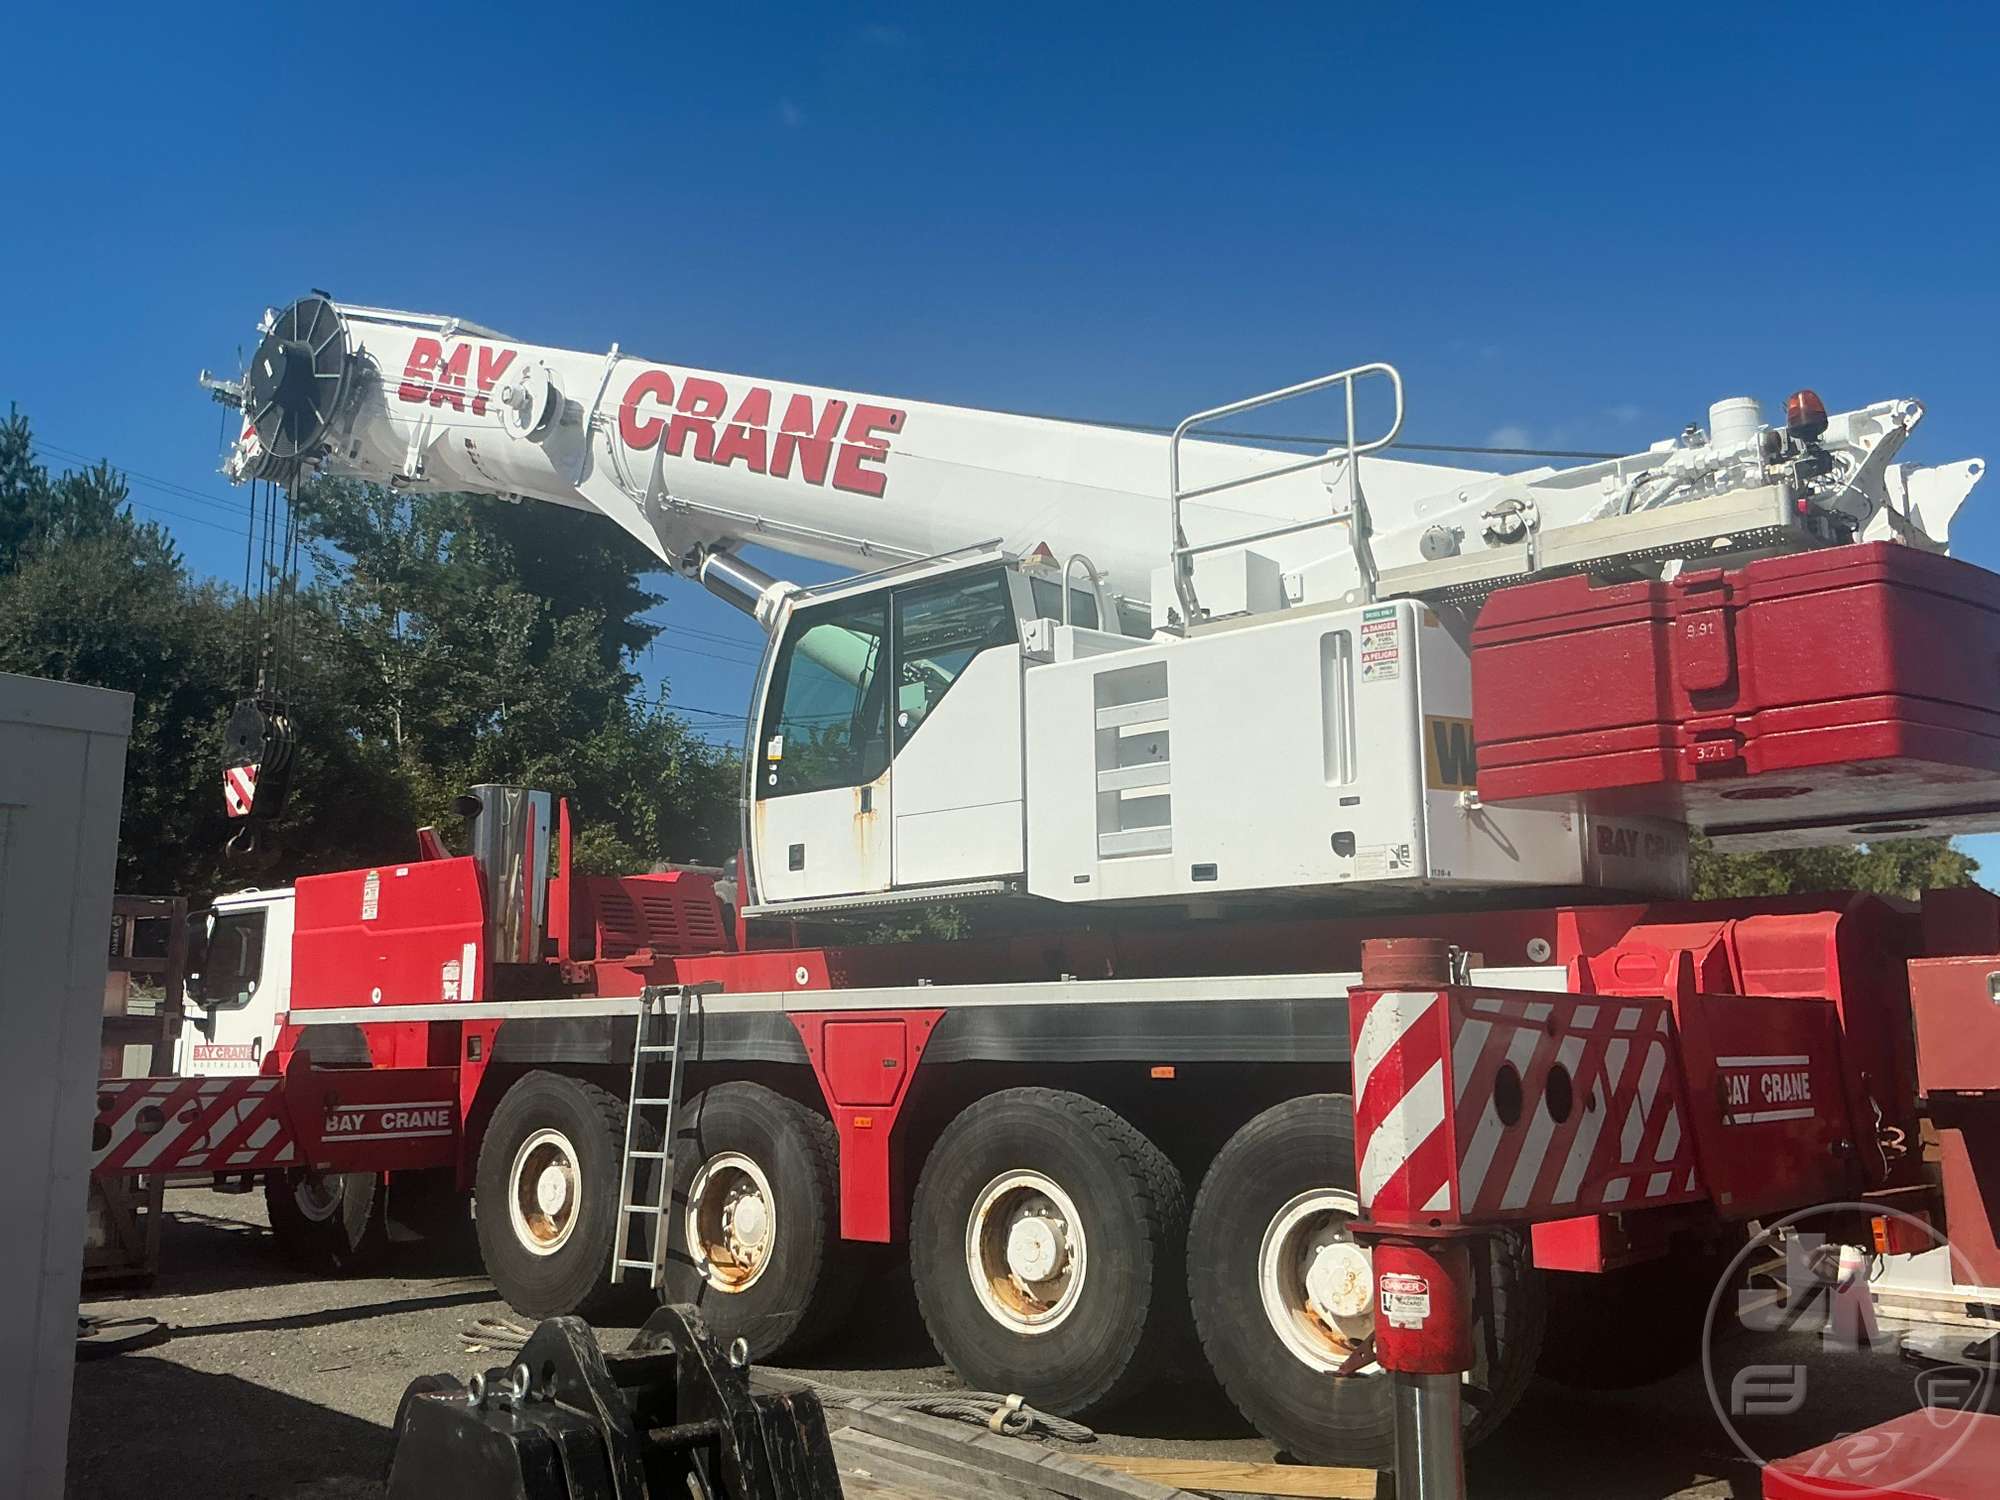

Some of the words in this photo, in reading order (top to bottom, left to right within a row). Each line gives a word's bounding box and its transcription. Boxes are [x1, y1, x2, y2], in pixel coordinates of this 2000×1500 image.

[398, 336, 518, 417] BAY
[619, 370, 907, 499] CRANE
[1369, 621, 1396, 632] DANGER
[1370, 650, 1397, 661] PELIGRO
[1596, 825, 1640, 858] BAY
[194, 1046, 214, 1058] BAY
[216, 1046, 253, 1058] CRANE
[1761, 1072, 1811, 1103] CRANE
[325, 1113, 365, 1132] BAY
[381, 1110, 450, 1130] CRANE
